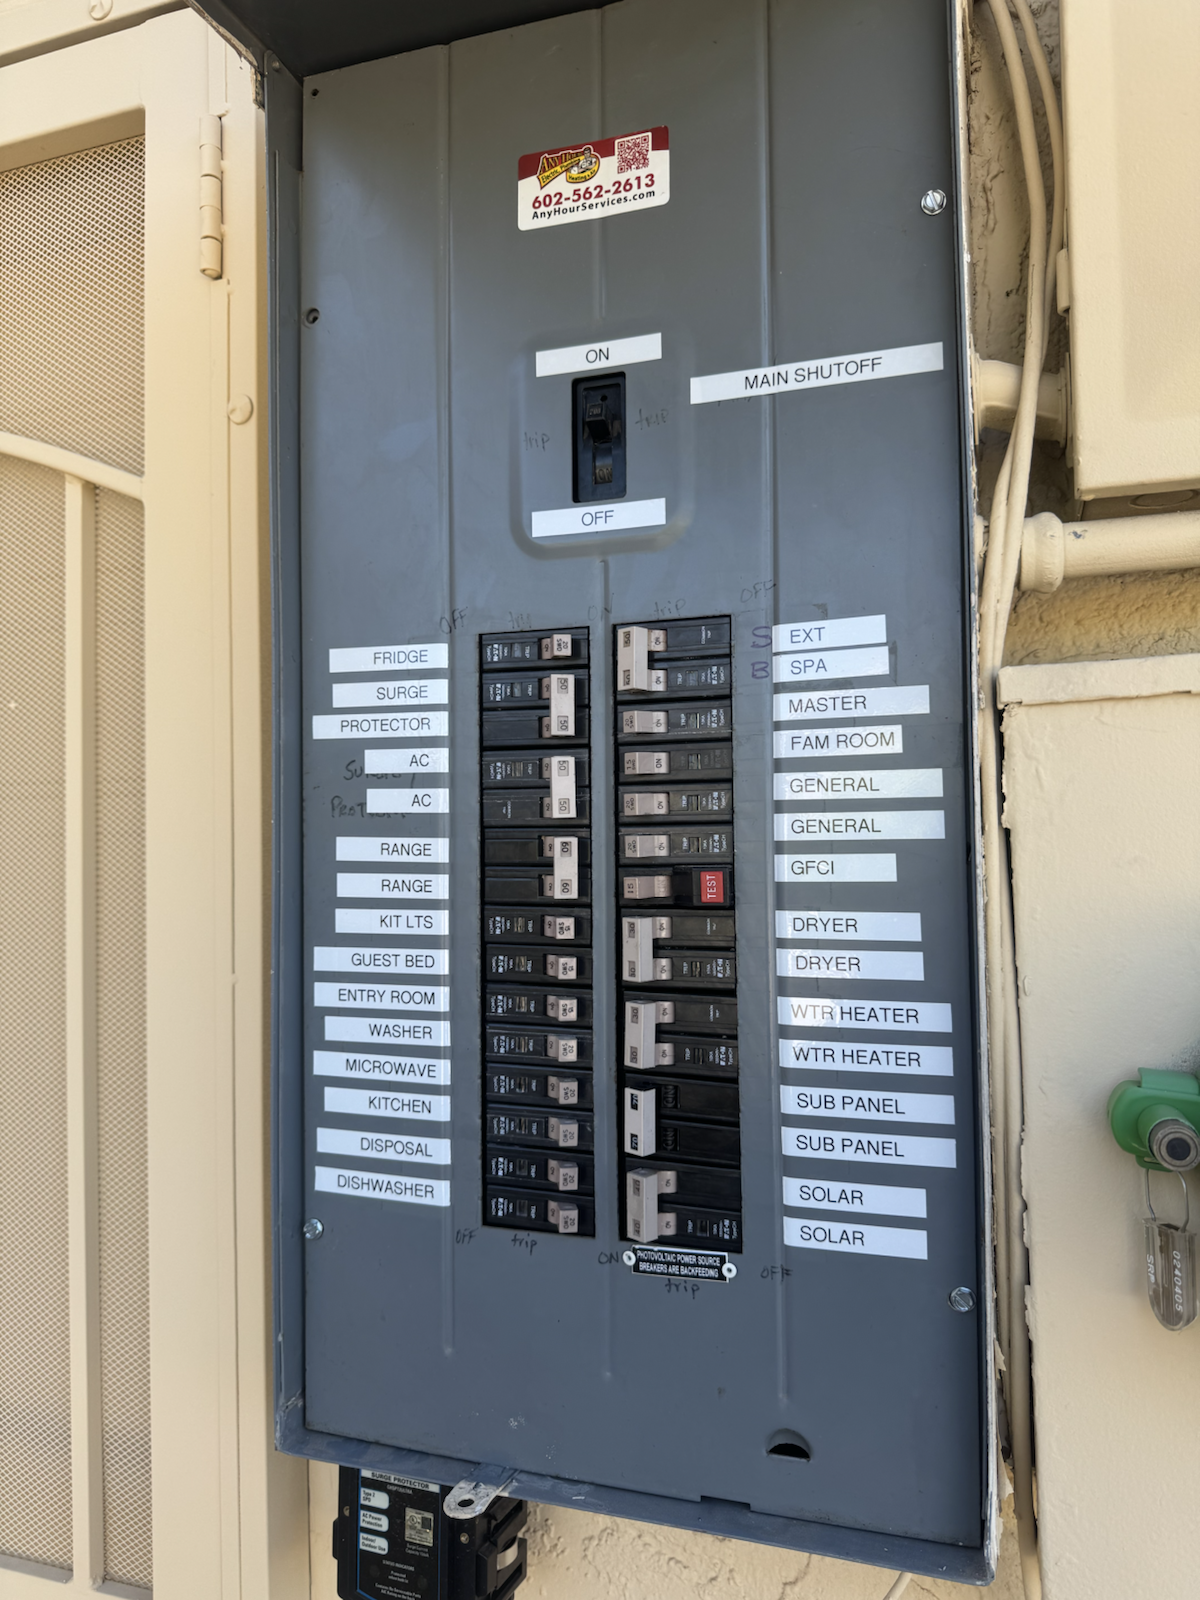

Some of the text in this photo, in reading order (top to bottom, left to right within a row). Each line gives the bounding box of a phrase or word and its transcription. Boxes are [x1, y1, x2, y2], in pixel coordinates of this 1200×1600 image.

[532, 173, 655, 209] 602-562-2613
[532, 190, 655, 220] AnyHourServices.com
[586, 348, 609, 364] ON
[744, 357, 882, 390] MAIN SHUTOFF
[581, 510, 614, 526] OFF
[624, 634, 630, 645] 50
[790, 627, 826, 644] EXT
[562, 641, 568, 649] 20
[373, 650, 428, 665] FRIDGE
[790, 658, 827, 675] SPA
[560, 680, 568, 690] 50
[376, 685, 428, 701] SURGE
[789, 695, 867, 714] MASTER
[340, 717, 431, 732] PROTECTOR
[560, 720, 568, 731] 50
[625, 718, 629, 727] 20
[791, 732, 894, 750] FAM ROOM
[409, 754, 430, 767] AC
[558, 761, 566, 771] 50
[627, 759, 631, 770] 15
[655, 758, 662, 768] ON
[790, 777, 880, 793] GENERAL
[411, 794, 432, 807] AC
[560, 801, 566, 811] 50
[626, 800, 630, 809] 20
[791, 818, 881, 834] GENERAL
[380, 843, 432, 857] RANGE
[561, 842, 569, 853] 60
[628, 842, 632, 850] 20
[791, 860, 835, 875] GFCI
[381, 879, 433, 893] RANGE
[562, 882, 569, 893] 60
[627, 882, 634, 894] 15
[706, 874, 716, 899] TEST
[380, 915, 434, 929] KIT LTS
[630, 923, 635, 934] 30
[793, 917, 858, 933] DRYER
[351, 953, 435, 968] GUEST BED
[795, 955, 861, 971] DRYER
[630, 966, 635, 977] 30
[338, 988, 435, 1005] ENTRY ROOM
[633, 1009, 638, 1020] 30
[791, 1004, 919, 1024] WTR HEATER
[369, 1024, 433, 1040] WASHER
[568, 1045, 574, 1053] 20
[632, 1051, 637, 1062] 30
[793, 1047, 921, 1068] WTR HEATER
[346, 1058, 437, 1078] MICROWAVE
[570, 1088, 576, 1097] 20
[368, 1096, 432, 1114] KITCHEN
[797, 1093, 906, 1115] SUB PANEL
[568, 1130, 575, 1140] 20
[360, 1137, 433, 1157] DISPOSAL
[796, 1134, 905, 1157] SUB PANEL
[337, 1174, 435, 1199] DISHWASHER
[569, 1174, 575, 1184] 20
[635, 1180, 640, 1192] 40
[799, 1185, 864, 1206] SOLAR
[569, 1218, 575, 1227] 20
[634, 1222, 640, 1236] 40
[456, 1228, 478, 1244] OFF
[800, 1225, 865, 1246] SOLAR
[511, 1233, 538, 1256] trip
[598, 1251, 619, 1264] ON
[637, 1250, 720, 1266] PHOTOVOLTAIC POWER SOURCE
[639, 1262, 718, 1277] BREAKERS ARE BACKFEEDING
[760, 1264, 793, 1282] OFF
[1146, 1253, 1155, 1284] SRP
[665, 1278, 700, 1299] trip
[1172, 1250, 1183, 1312] 0240405
[371, 1472, 392, 1481] SURGE
[393, 1476, 430, 1490] PROTECTOR
[362, 1519, 383, 1528] Protection
[369, 1514, 382, 1522] Power
[361, 1542, 377, 1550] Outdoor
